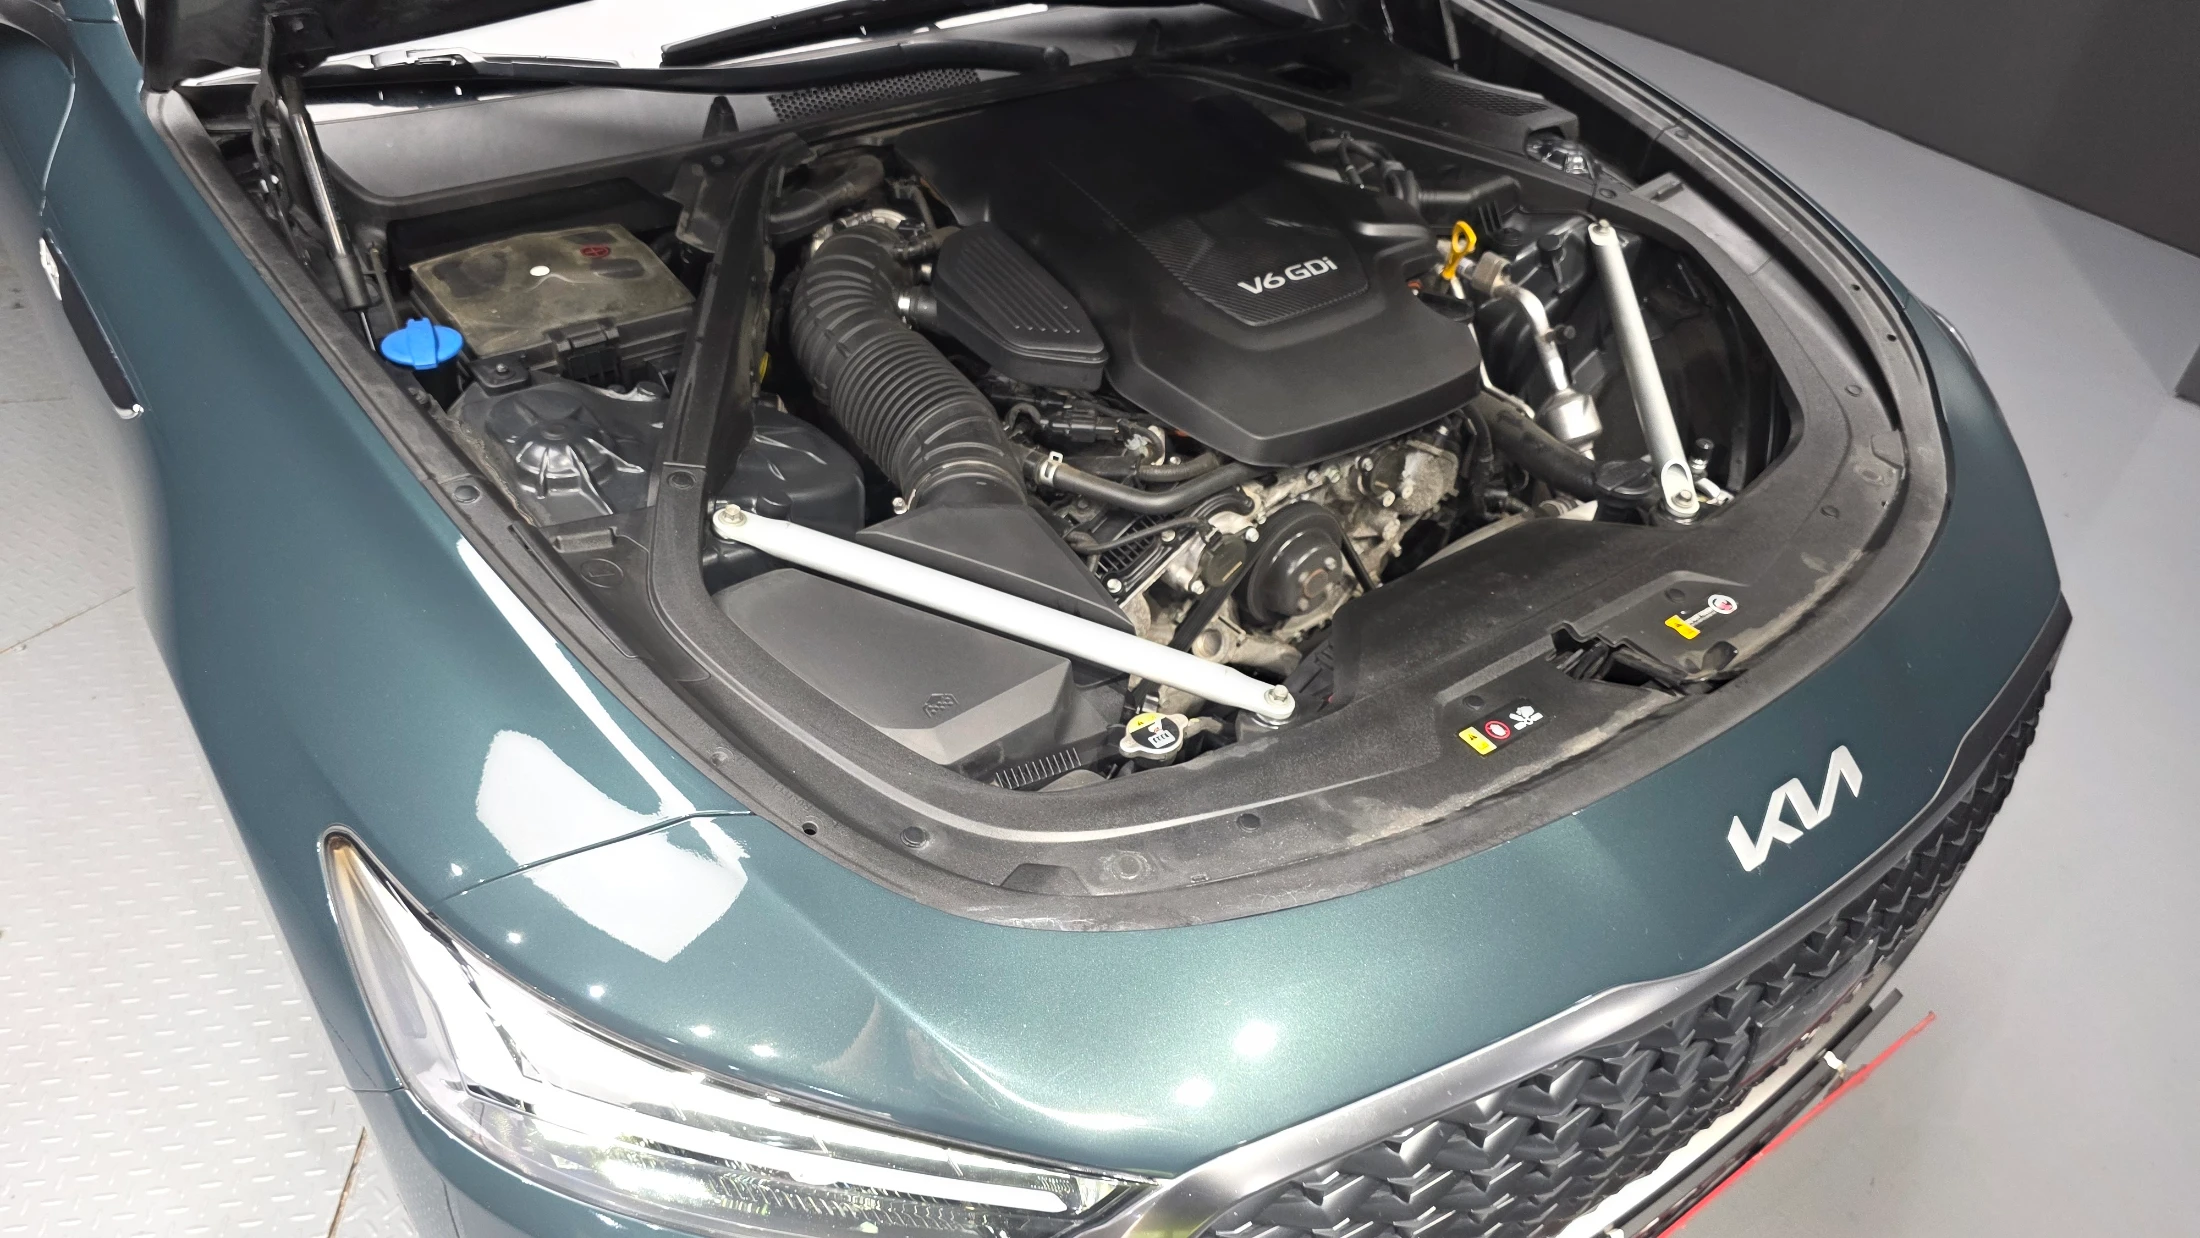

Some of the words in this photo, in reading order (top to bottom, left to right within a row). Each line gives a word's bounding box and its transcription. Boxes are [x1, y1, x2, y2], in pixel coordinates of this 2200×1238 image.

[1237, 271, 1286, 295] V6
[1284, 256, 1338, 281] GDi
[1727, 744, 1863, 872] KIA
